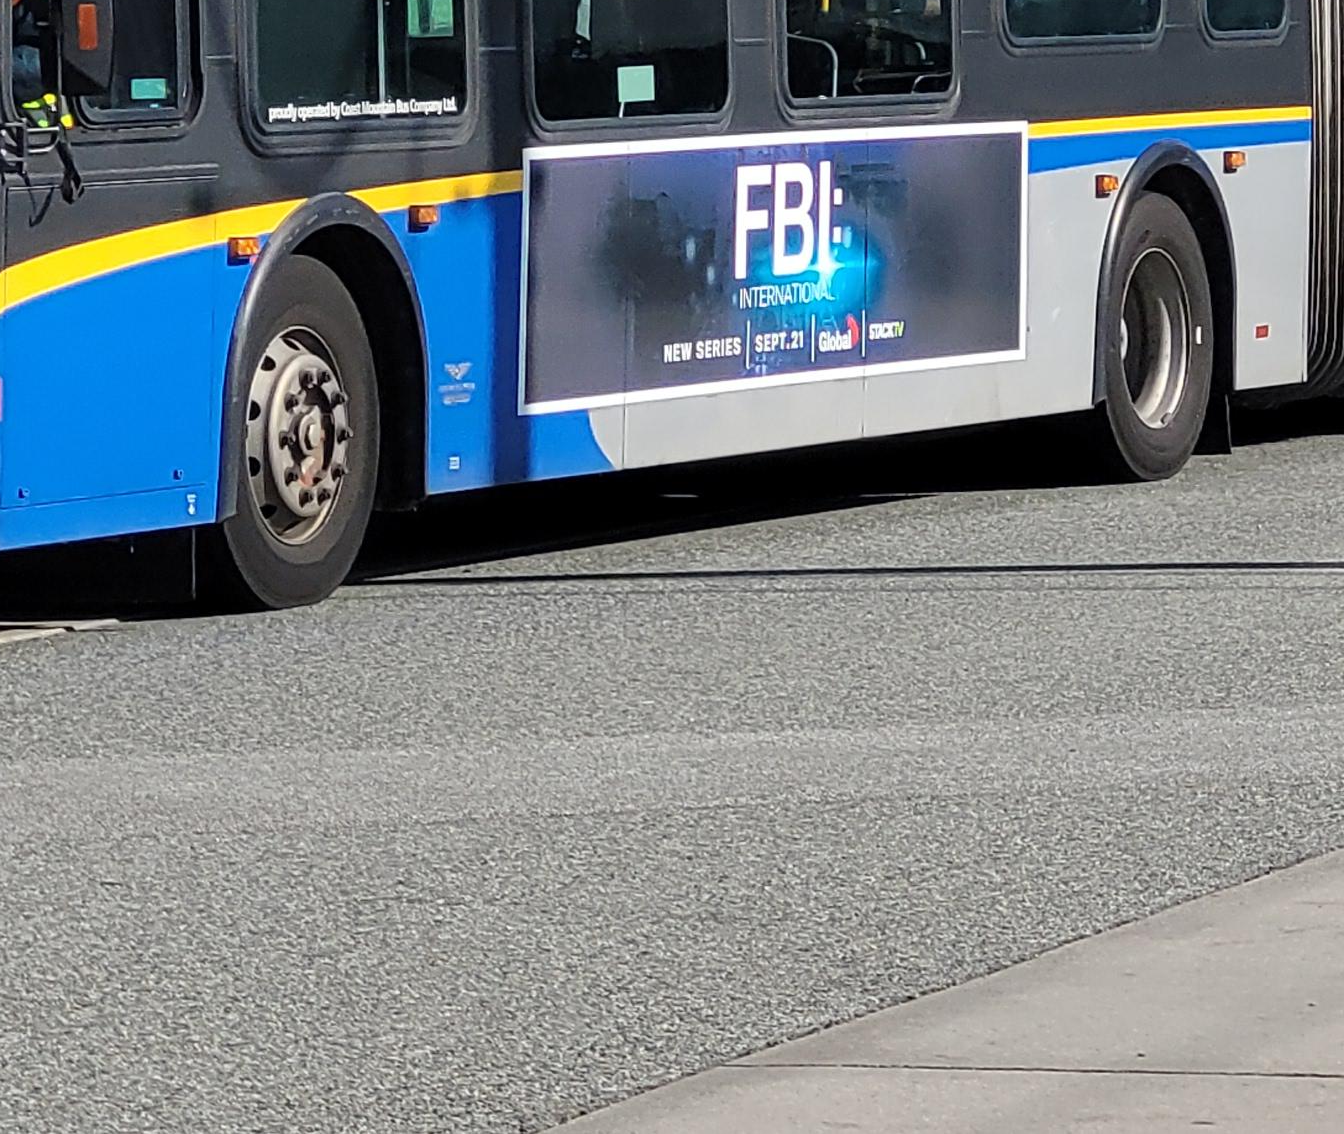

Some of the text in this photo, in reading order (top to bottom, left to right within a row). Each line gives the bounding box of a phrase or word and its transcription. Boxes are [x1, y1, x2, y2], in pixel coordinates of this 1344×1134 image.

[268, 103, 296, 123] proudly
[298, 102, 330, 121] operated
[331, 101, 341, 120] by
[362, 100, 395, 115] Mountain
[396, 99, 409, 114] Bus
[410, 98, 442, 115] Company
[443, 96, 457, 112] Ltd.
[734, 160, 843, 279] FBI:
[739, 282, 836, 309] INTERNATIONAL
[663, 342, 692, 363] NEW
[695, 338, 742, 360] SERIES
[818, 330, 852, 353] Global
